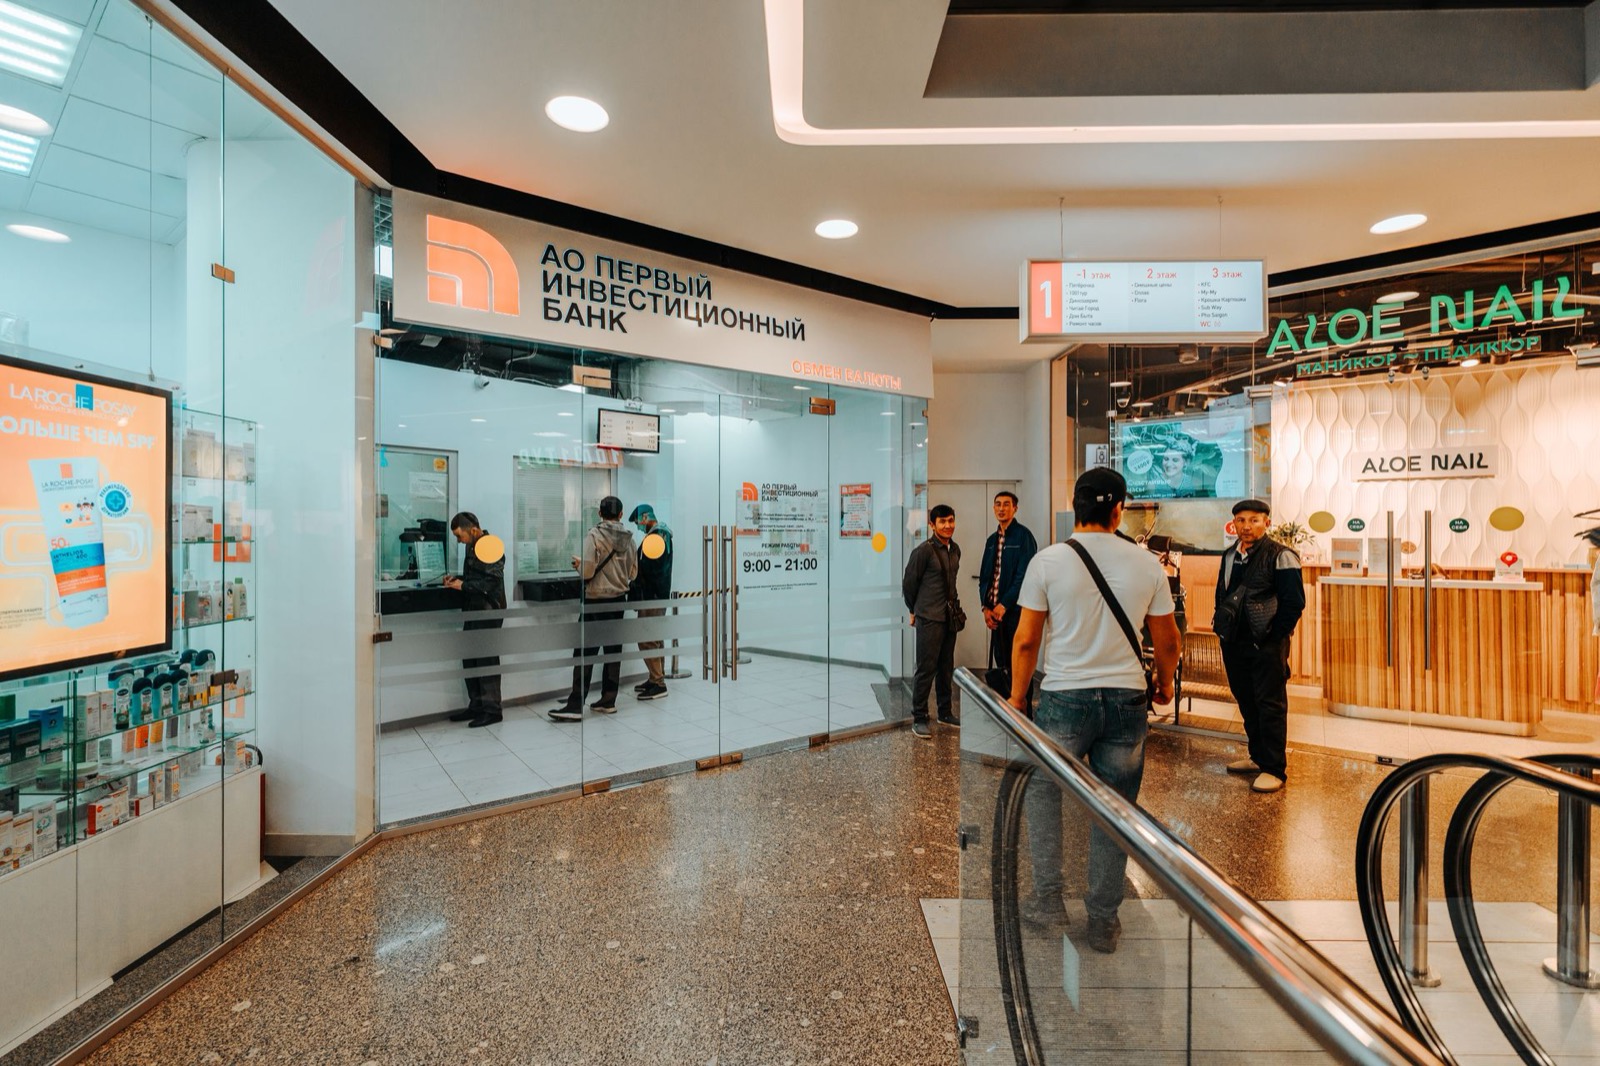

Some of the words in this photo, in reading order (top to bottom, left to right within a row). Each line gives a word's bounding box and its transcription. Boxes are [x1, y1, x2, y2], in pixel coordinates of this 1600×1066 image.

[540, 244, 585, 273] АО
[595, 254, 712, 300] ПЕРВЫЙ
[1146, 267, 1153, 279] 2
[1156, 271, 1177, 279] этаж
[1212, 267, 1219, 279] 3
[1221, 271, 1243, 279] этаж
[541, 269, 806, 342] ИНВЕСТИЦИОННЫЙ
[1040, 280, 1052, 318] 1
[543, 297, 628, 334] БАНК
[1266, 301, 1405, 357] ALOE
[1430, 276, 1585, 334] NAIL
[1296, 353, 1397, 376] МАНИКЮР
[1424, 336, 1540, 361] ПЕДИКЮР
[791, 359, 842, 380] ОБМЕН
[845, 367, 903, 390] ВАЛЮТЫ
[8, 383, 33, 402] LA
[0, 415, 80, 442] ОЛЬШЕ
[84, 425, 124, 447] ЧЕМ
[1361, 455, 1422, 474] ALOE
[1431, 452, 1489, 471] NAIL
[761, 489, 819, 497] ИНВЕСТИЦИОННЫЙ
[771, 482, 797, 491] ПЕРВЫЙ
[743, 559, 771, 573] 9:00
[785, 557, 818, 571] 21:00
